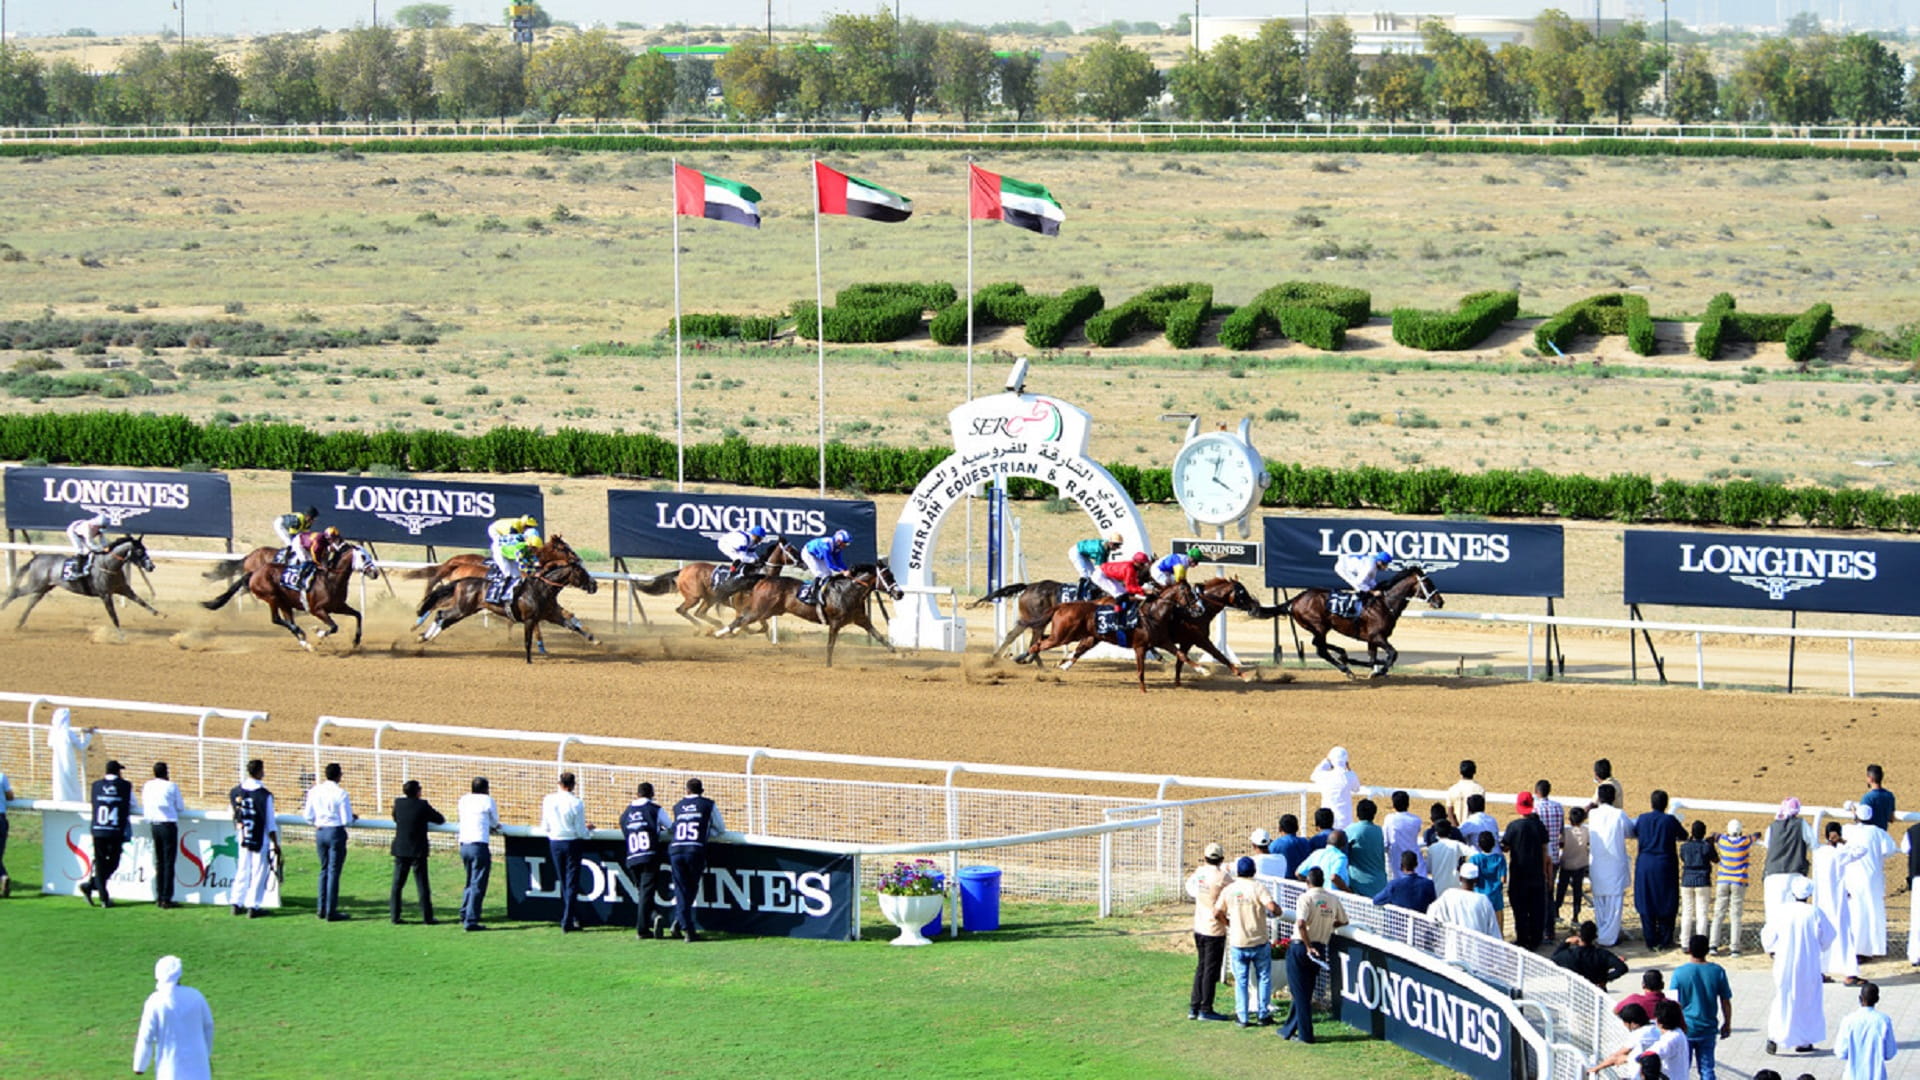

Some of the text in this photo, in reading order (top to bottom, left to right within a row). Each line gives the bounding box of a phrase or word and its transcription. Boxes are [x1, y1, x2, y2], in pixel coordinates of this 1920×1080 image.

[43, 477, 190, 509] LONGINES
[334, 485, 496, 518] LONGINES
[656, 502, 827, 536] LONGINES
[908, 461, 1113, 570] SHARJAH EQUESTRIAN & RACING
[1318, 528, 1511, 563] LONGINES
[1679, 543, 1877, 580] LONGINES
[1098, 615, 1108, 630] 3
[97, 804, 119, 826] 04
[675, 821, 700, 841] 05
[628, 831, 650, 854] 08
[1338, 951, 1502, 1061] LONGINES
